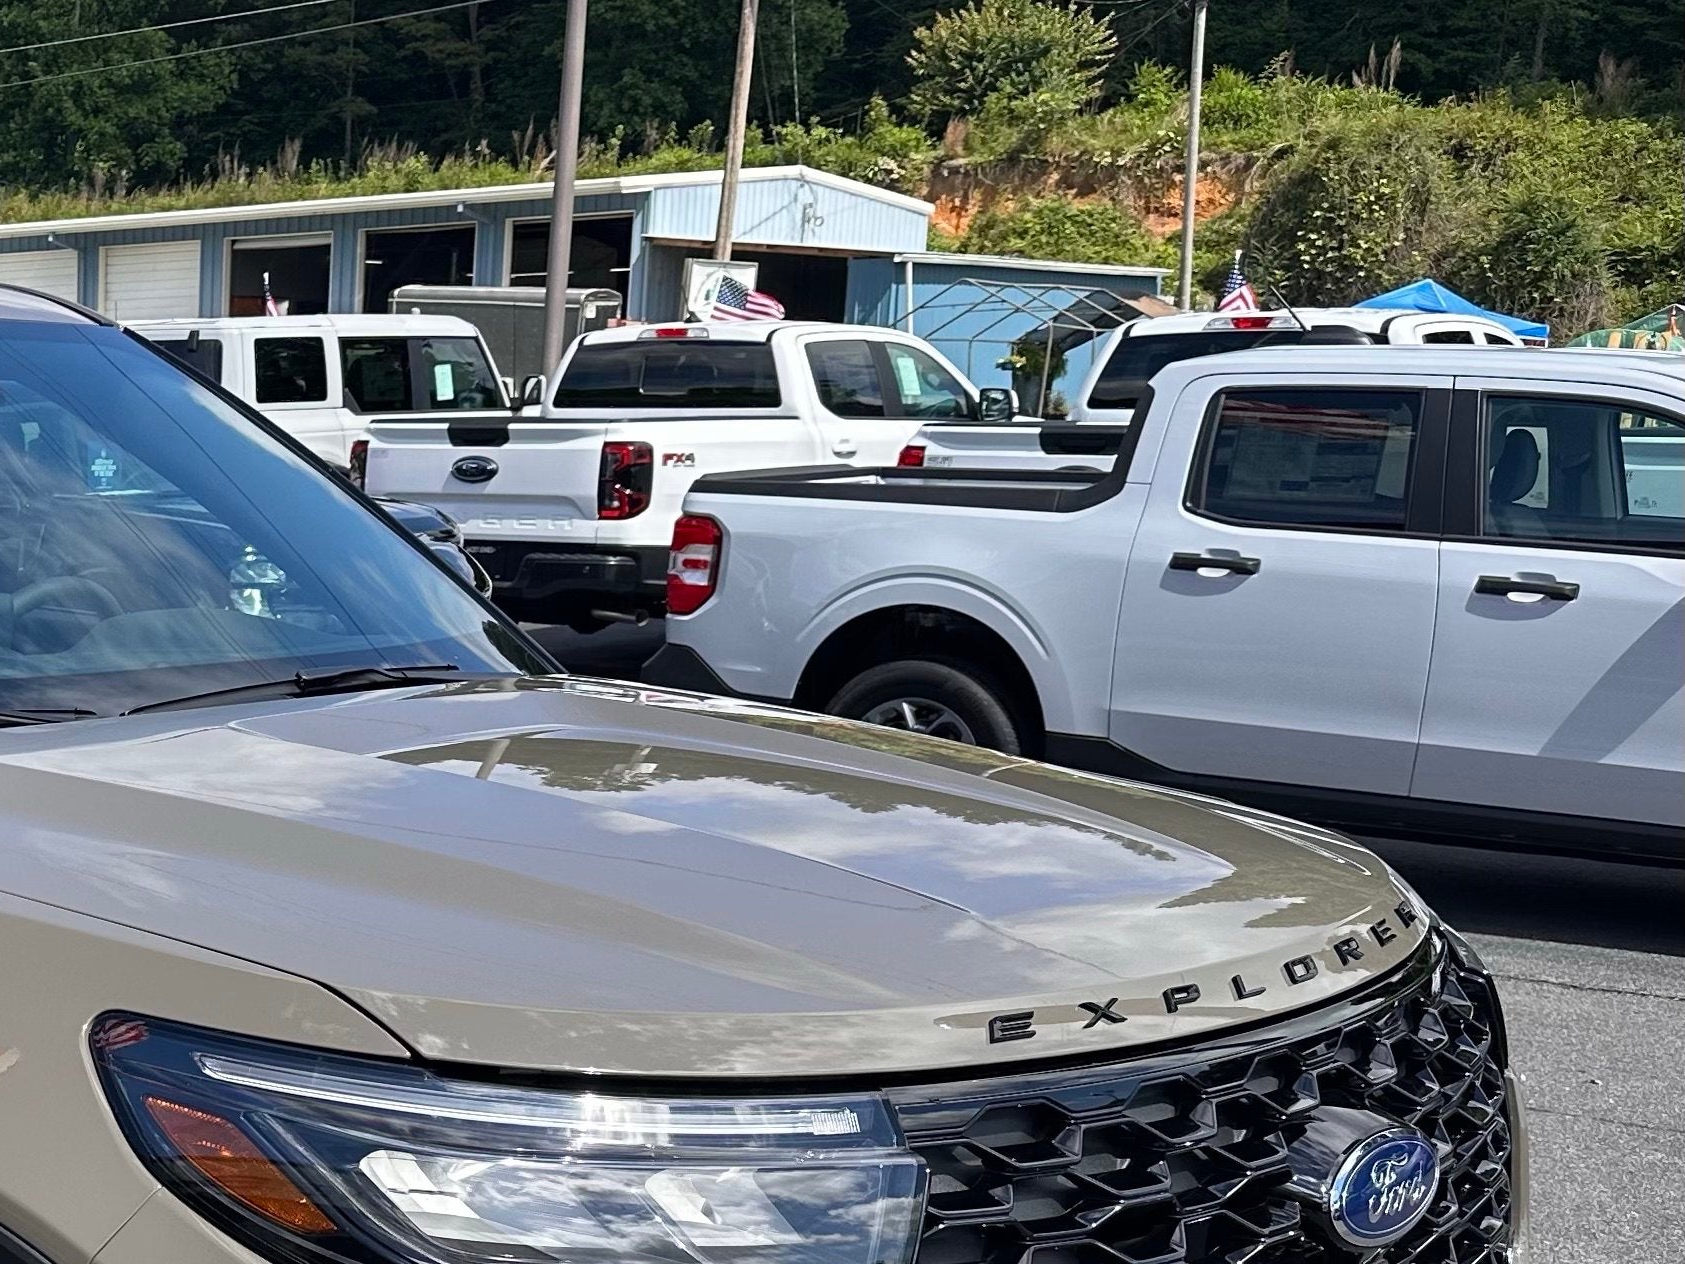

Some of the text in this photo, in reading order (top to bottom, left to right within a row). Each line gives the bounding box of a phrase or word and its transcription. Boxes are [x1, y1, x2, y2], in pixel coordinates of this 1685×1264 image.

[661, 452, 696, 467] FX4
[988, 900, 1418, 1045] EXPLORER
[1368, 1145, 1428, 1224] Ford
